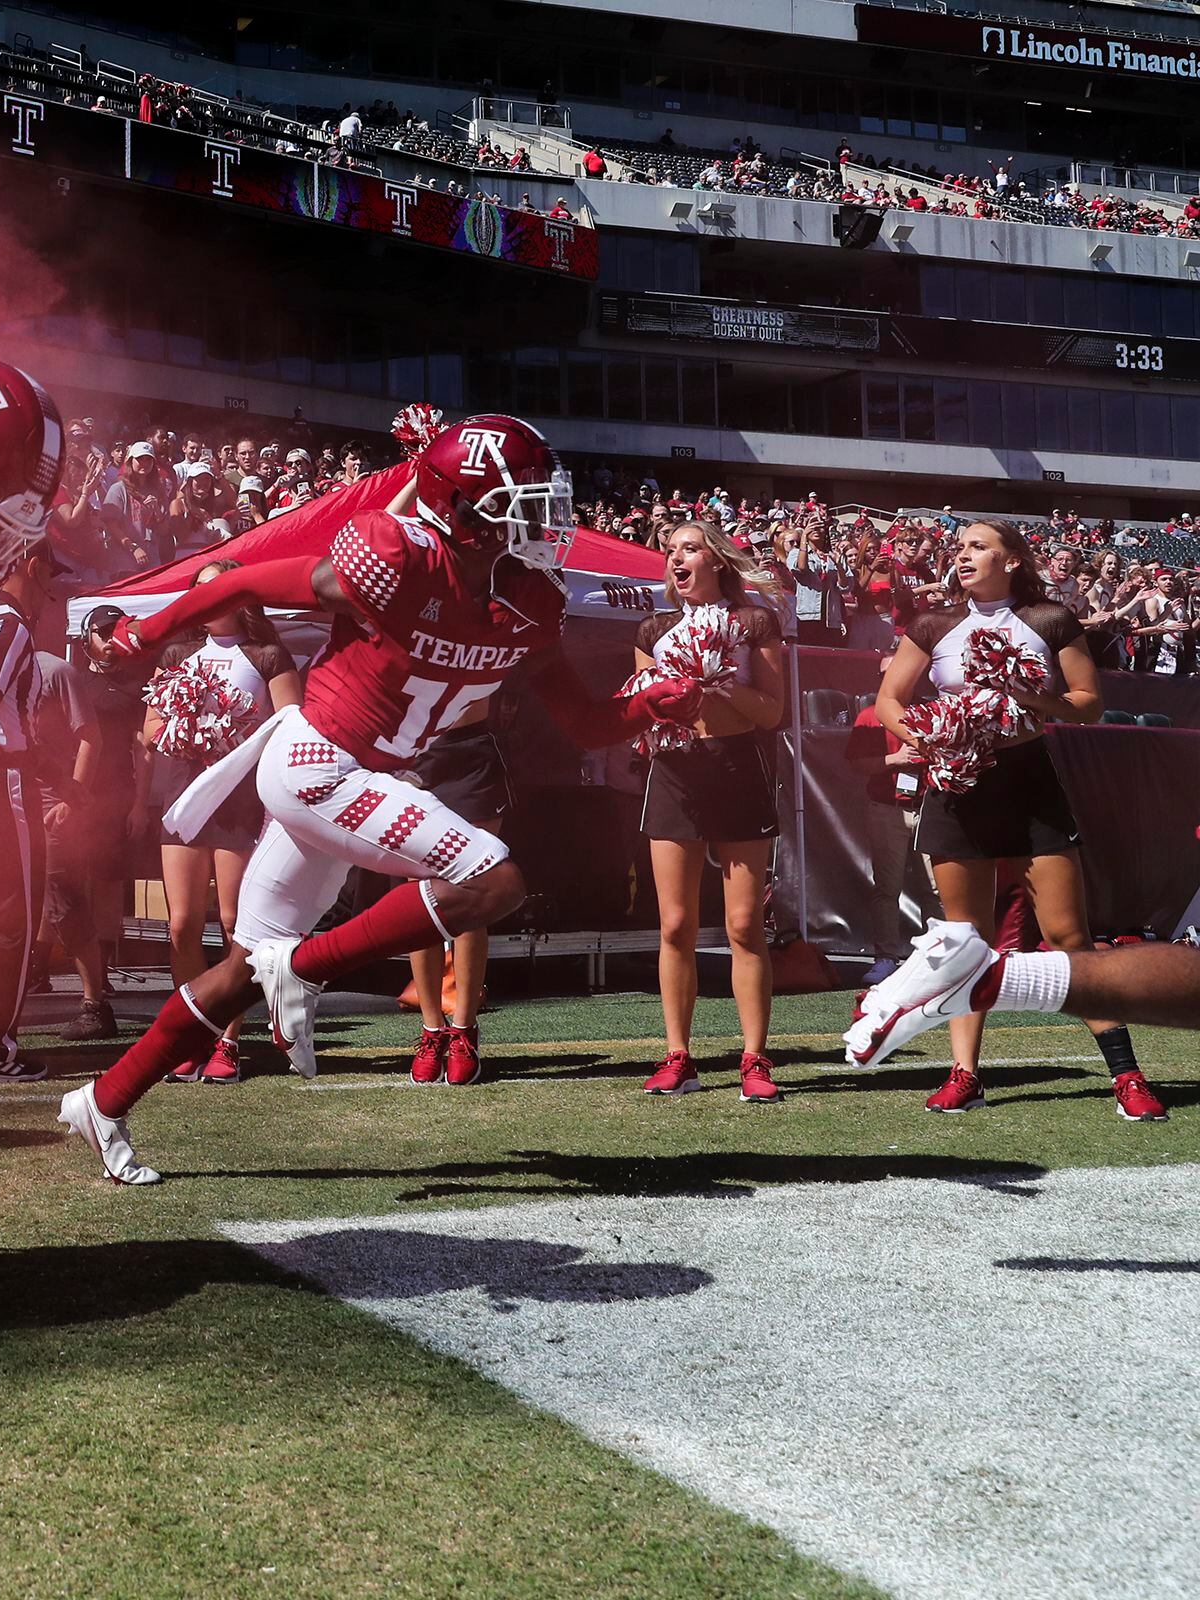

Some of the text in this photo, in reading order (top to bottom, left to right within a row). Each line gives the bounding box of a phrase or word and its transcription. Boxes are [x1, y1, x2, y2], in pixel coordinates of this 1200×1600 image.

[1010, 29, 1200, 78] Lincoln Financi
[712, 305, 784, 327] GREATNESS
[713, 323, 757, 339] DOESN'T
[1115, 343, 1163, 371] 3:33
[228, 398, 246, 409] 104
[457, 428, 507, 477] T
[675, 447, 693, 458] 103
[1046, 471, 1062, 481] 102
[601, 581, 655, 613] OWLS
[409, 629, 529, 671] TEMPLE
